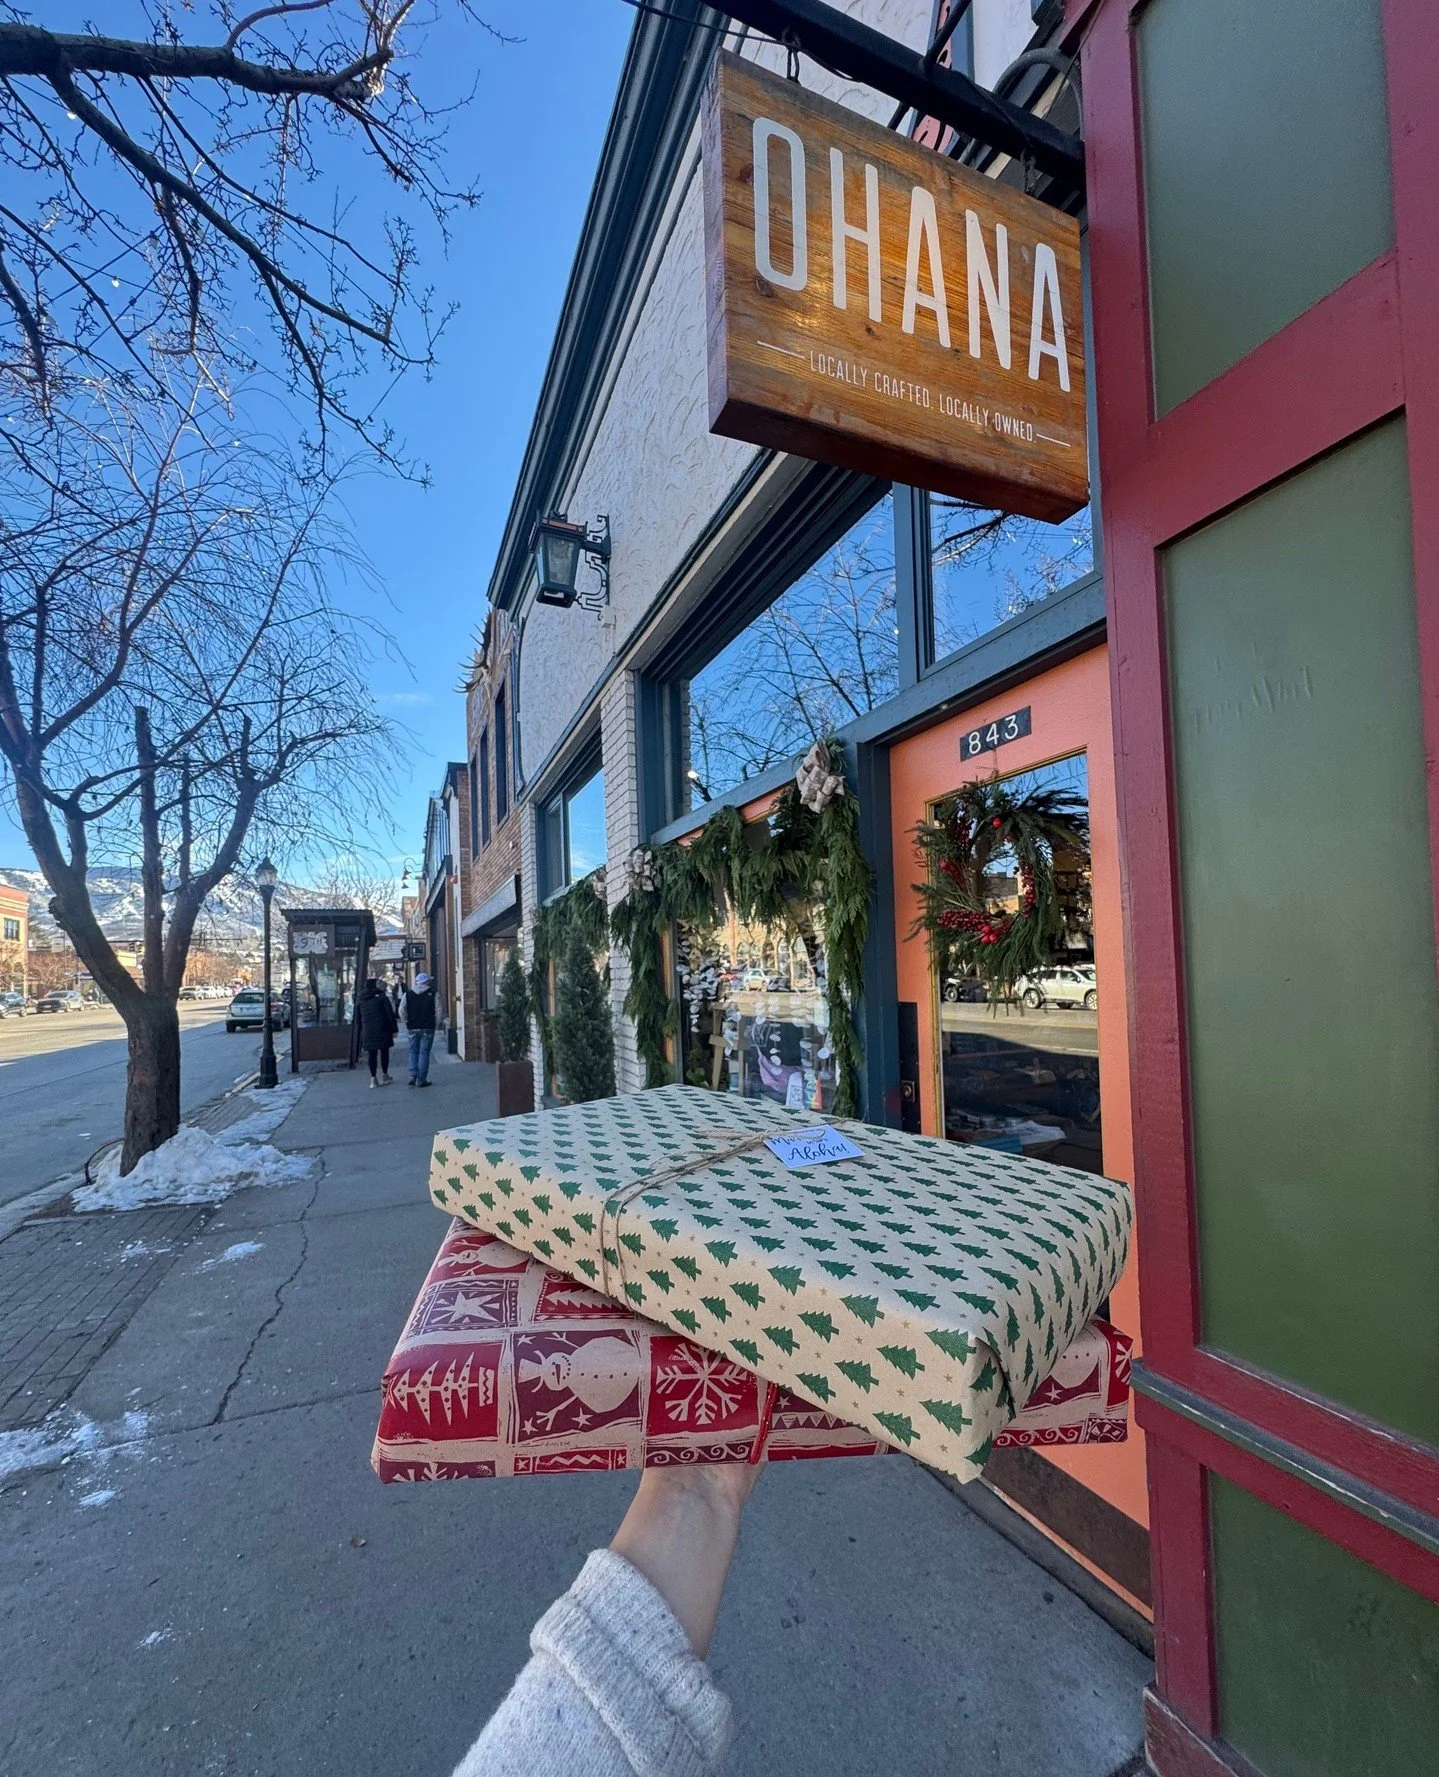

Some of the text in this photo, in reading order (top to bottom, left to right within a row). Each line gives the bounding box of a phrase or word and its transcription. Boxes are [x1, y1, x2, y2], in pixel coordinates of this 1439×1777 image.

[752, 117, 1071, 393] OHANA
[810, 350, 1037, 443] LOCALLY CRAFTED. LOCALLY OWNED.
[968, 714, 1019, 755] 843
[787, 1142, 850, 1161] Aloha!
